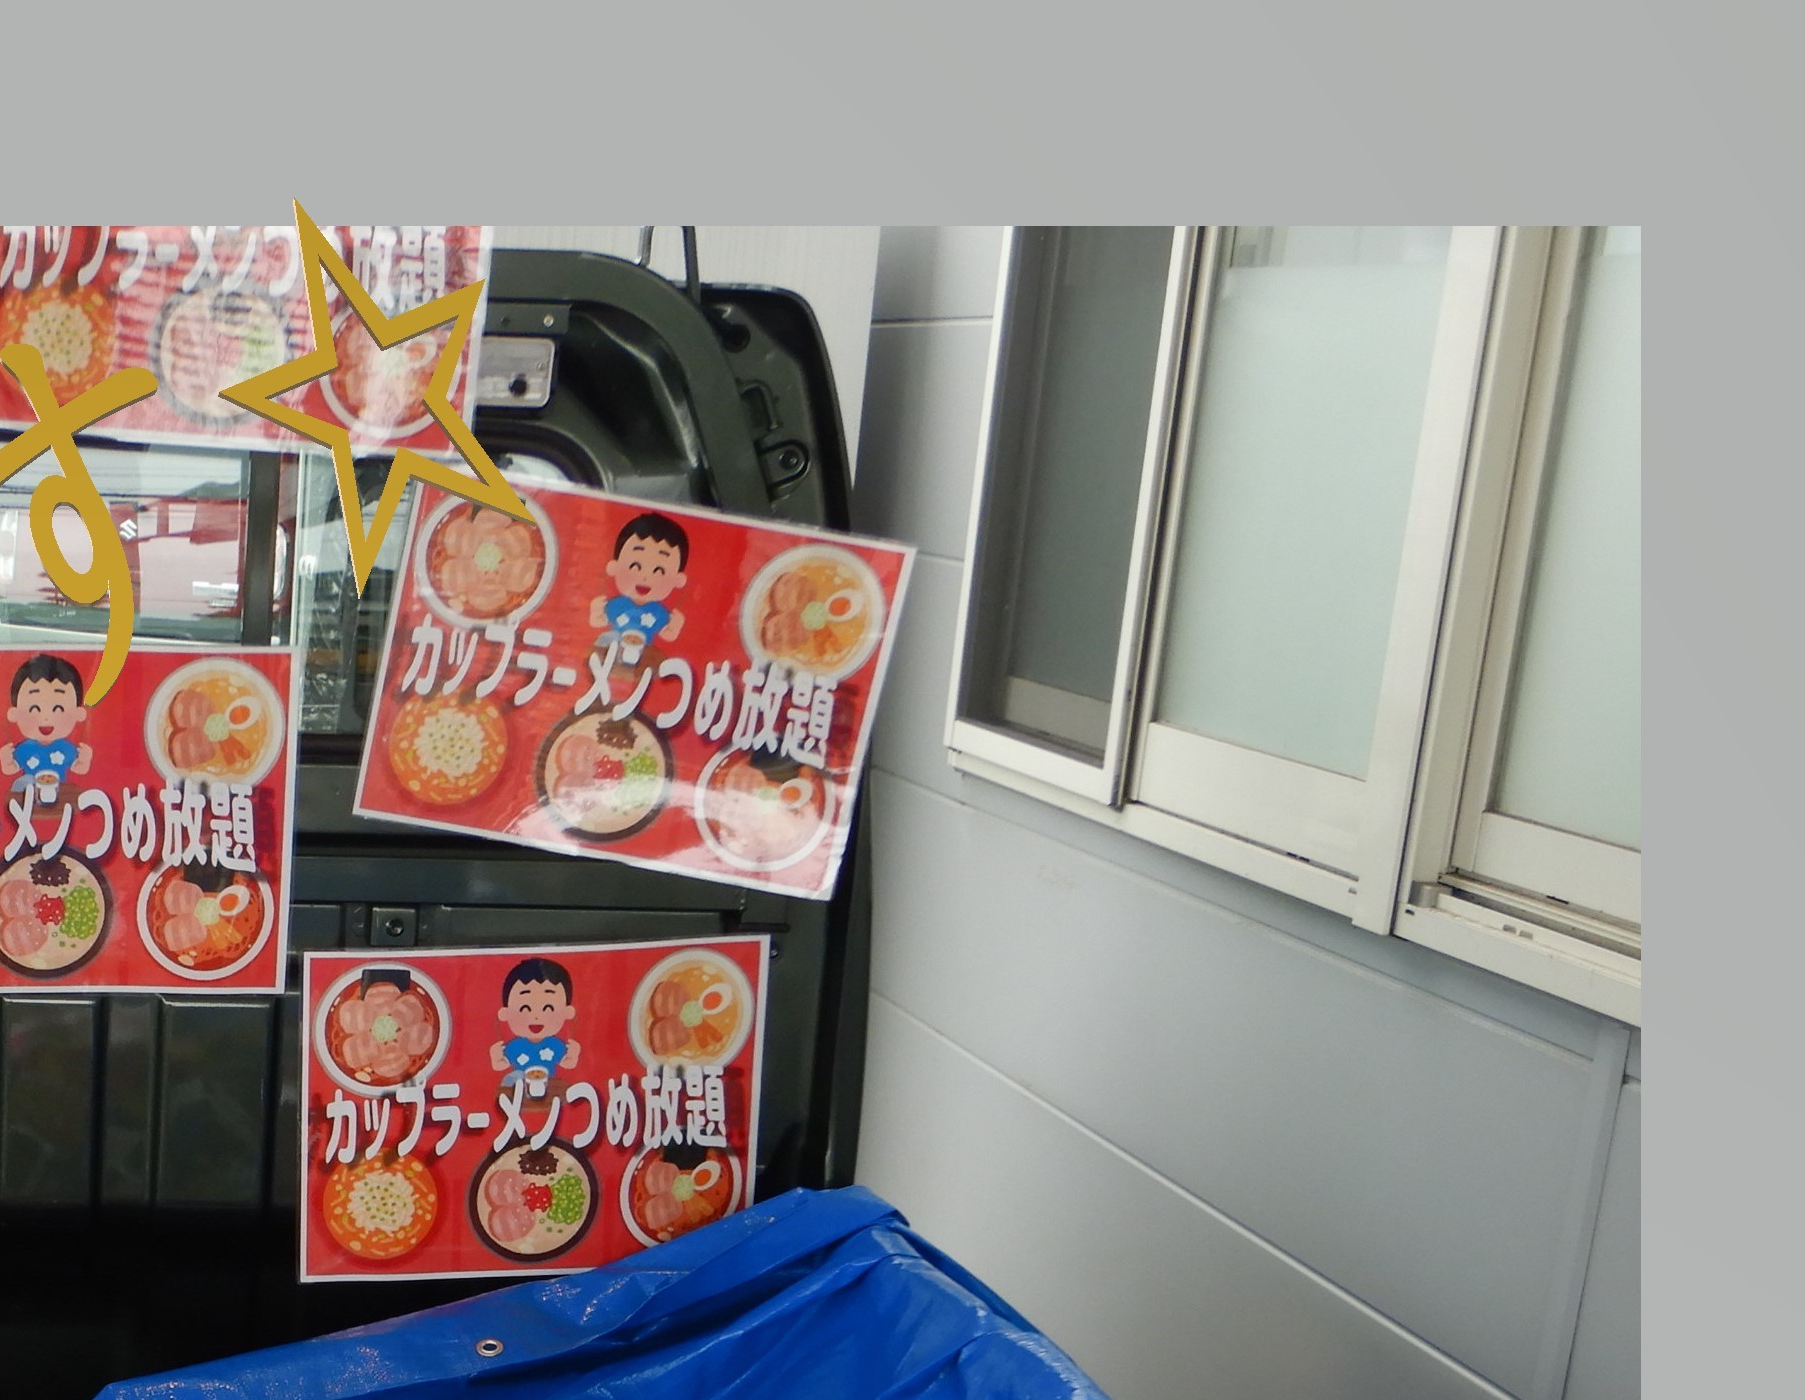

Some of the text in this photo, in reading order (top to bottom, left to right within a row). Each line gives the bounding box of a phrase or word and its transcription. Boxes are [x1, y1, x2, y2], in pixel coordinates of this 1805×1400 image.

[403, 614, 838, 769] カップラーメンつめ放題
[325, 1064, 727, 1164] カップラーメンつめ放題
